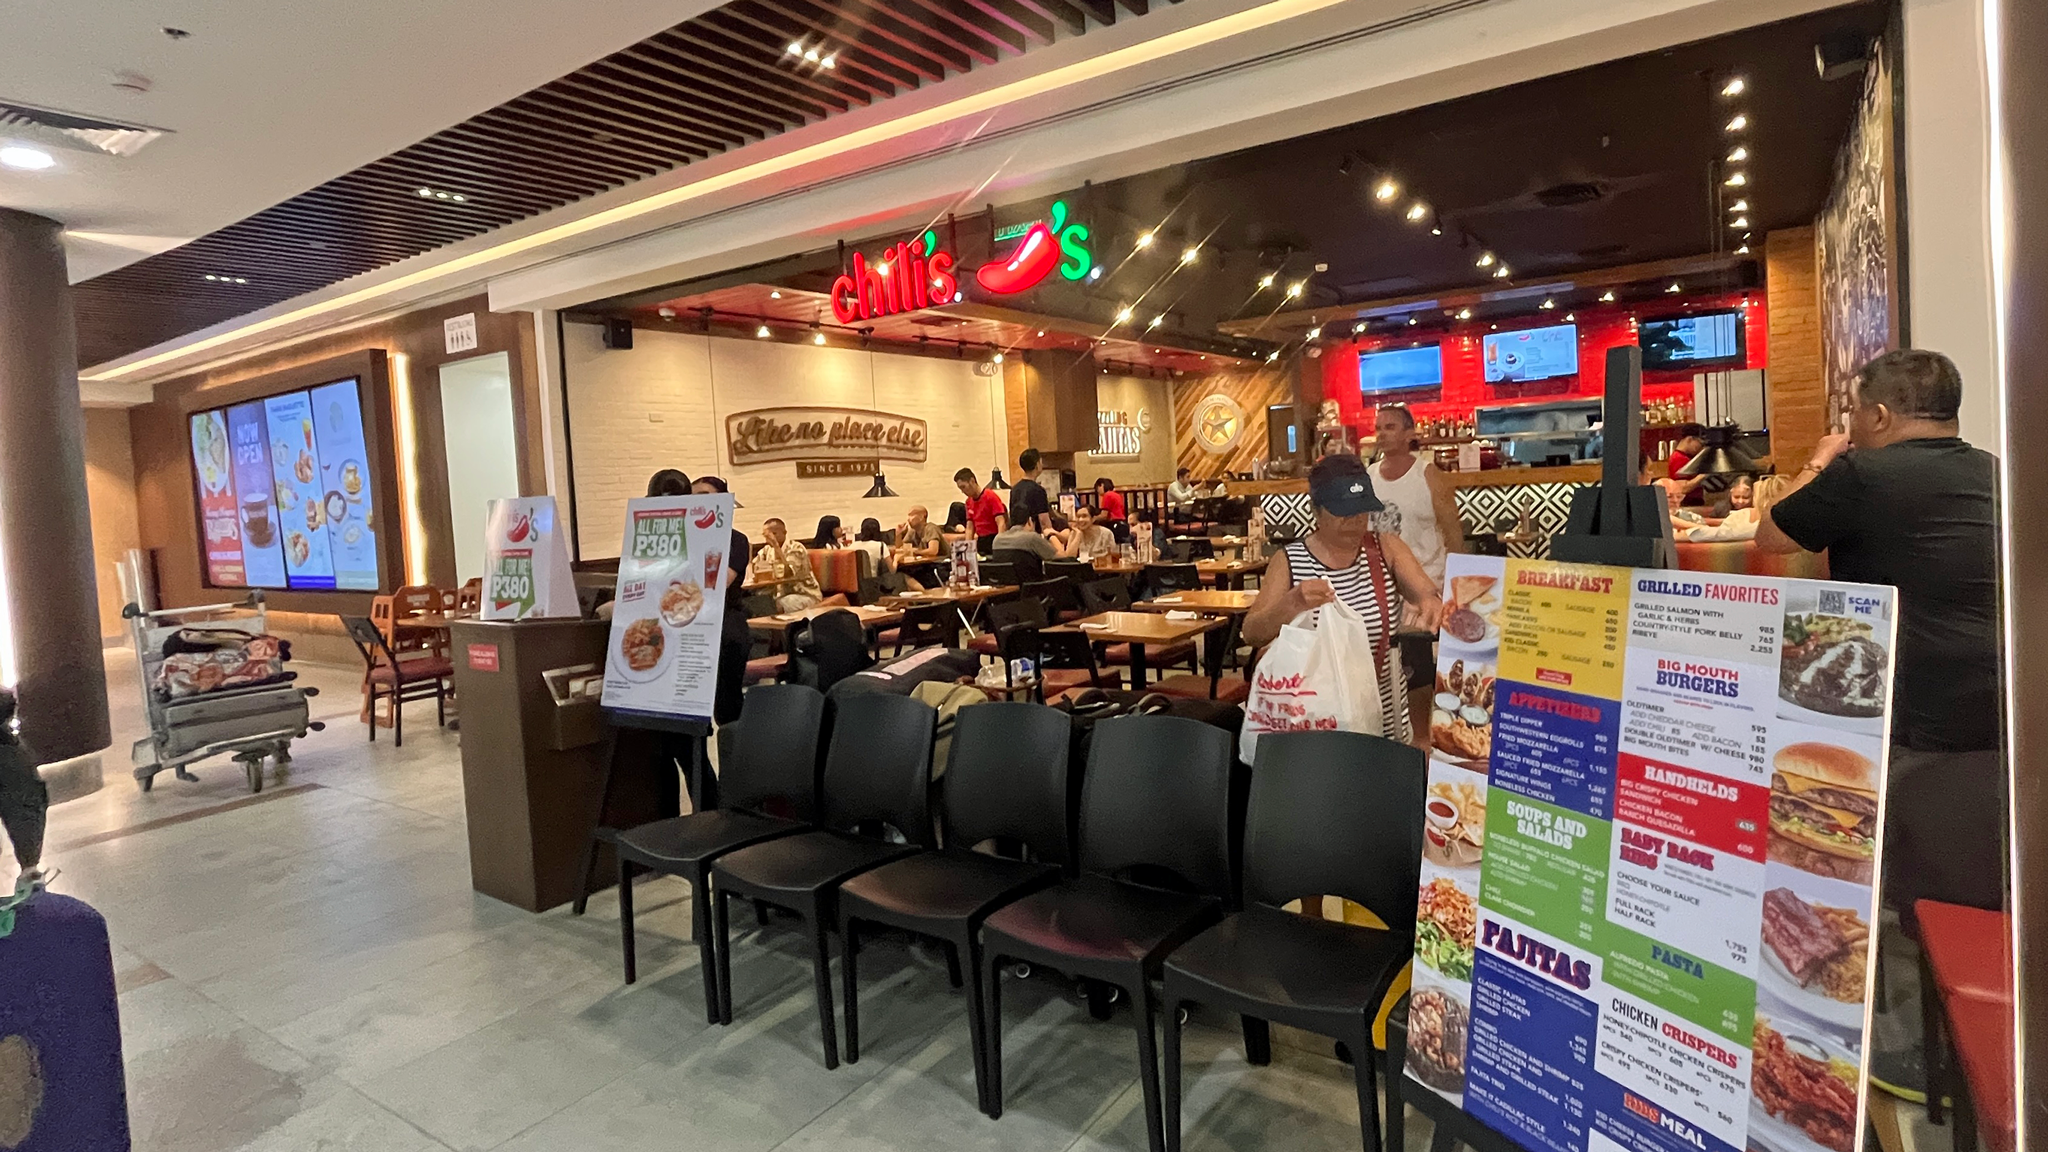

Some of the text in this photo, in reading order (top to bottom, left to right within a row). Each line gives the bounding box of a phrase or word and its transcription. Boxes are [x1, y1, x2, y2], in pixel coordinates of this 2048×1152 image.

[831, 231, 957, 324] chili's
[806, 465, 842, 473] SINCE
[637, 519, 651, 534] ALL
[652, 518, 668, 534] FOR
[634, 534, 681, 557] P380
[492, 577, 529, 599] P380
[1516, 569, 1613, 594] BREAKFAST
[1637, 579, 1778, 605] GRILLED FAVORITES
[1634, 603, 1723, 618] GRILLED SALMON WITH
[1849, 597, 1880, 606] SCAN
[1855, 606, 1872, 614] ME
[1637, 612, 1664, 620] GARLIC
[1632, 629, 1657, 637] RIBEYE
[1633, 620, 1691, 633] COUNTRY-STYLE
[1695, 628, 1716, 636] PORK
[1719, 631, 1742, 640] BELLY
[1657, 659, 1738, 680] BIG MOUTH
[1656, 669, 1739, 698] BURGERS
[1626, 700, 1664, 712] OLDTIMER
[1630, 710, 1646, 718] ADD
[1648, 713, 1682, 725] CHEDDAR
[1685, 721, 1715, 732] CHEESE
[1498, 732, 1515, 741] FRIED
[1624, 726, 1653, 738] DOUBLE
[1656, 733, 1695, 747] OLDTIMER
[1713, 746, 1745, 759] CHEESE
[1629, 718, 1645, 727] ADD
[1692, 732, 1709, 741] ADD
[1711, 736, 1741, 748] BACON
[1638, 739, 1666, 750] MOUTH
[1668, 746, 1689, 755] BITES
[1497, 751, 1521, 762] SAUCED
[1522, 757, 1540, 767] FRIED
[1530, 778, 1551, 789] WINGS
[1620, 778, 1698, 805] BIG CRISPY CHICKEN
[1644, 765, 1738, 802] HANDHELDS
[1506, 800, 1586, 838] SOUPS AND
[1619, 799, 1682, 822] CHICKEN BACON
[1517, 818, 1572, 850] SALADS
[1646, 816, 1695, 836] QUESADILLA
[1617, 871, 1647, 887] CHOOSE
[1650, 882, 1671, 895] YOUR
[1674, 891, 1699, 905] SAUCE
[1615, 898, 1654, 917] FULL RACK
[1615, 907, 1632, 918] HALF
[1635, 915, 1655, 927] RACK
[1481, 918, 1591, 993] FAJITAS
[1651, 945, 1703, 979] PASTA
[1503, 989, 1526, 1006] FAJITAS
[1502, 1006, 1521, 1020] STEAK
[1612, 997, 1737, 1069] CHICKEN CRISPERS
[1498, 1047, 1526, 1067] CHICKEN
[1499, 1039, 1526, 1059] CHICKEN
[1601, 1041, 1625, 1057] CRISPY
[1627, 1054, 1661, 1076] CHICKEN
[1669, 1046, 1704, 1068] CHICKEN
[1706, 1064, 1745, 1089] CRISPERS
[1719, 1081, 1734, 1094] 670
[1660, 1113, 1706, 1150] MEAL
